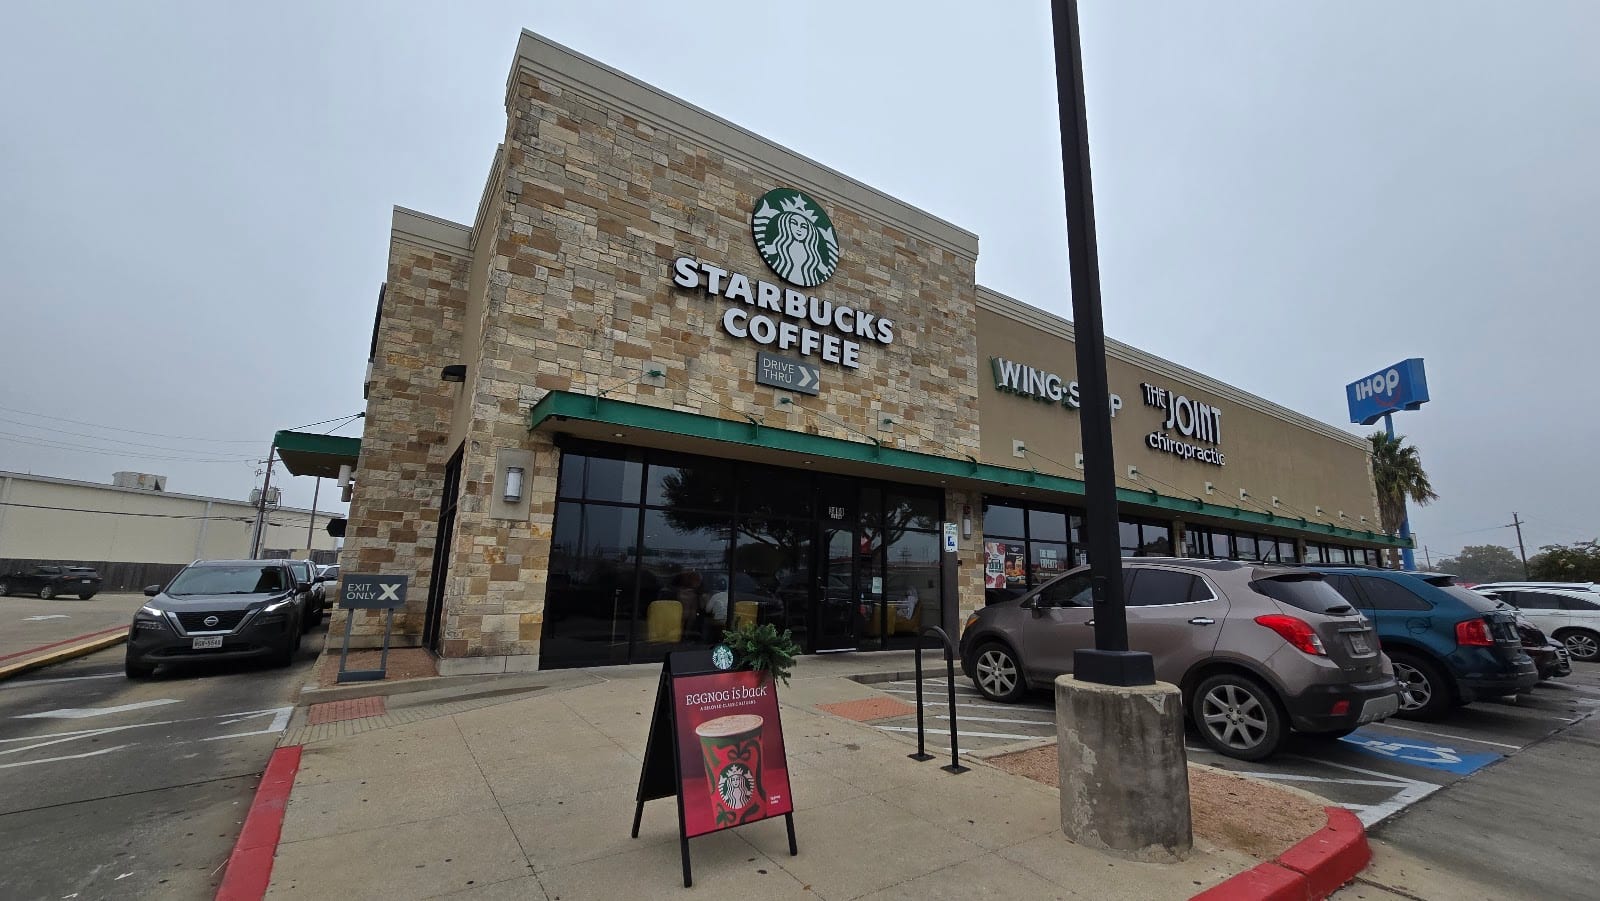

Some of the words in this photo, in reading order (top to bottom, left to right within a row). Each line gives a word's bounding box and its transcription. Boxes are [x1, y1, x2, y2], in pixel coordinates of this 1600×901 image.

[673, 256, 894, 344] STARBUCKS
[723, 307, 860, 369] COFFEE
[763, 357, 795, 374] DRIVE
[763, 368, 792, 384] THRU
[1355, 368, 1400, 402] IHOP
[1142, 382, 1167, 409] THE
[1166, 390, 1222, 445] JOINT
[1148, 430, 1226, 466] chiropractic
[346, 591, 376, 600] ONLY
[347, 583, 372, 592] EXIT
[685, 690, 730, 706] EGGNOG
[731, 686, 741, 700] is
[742, 685, 768, 699] back
